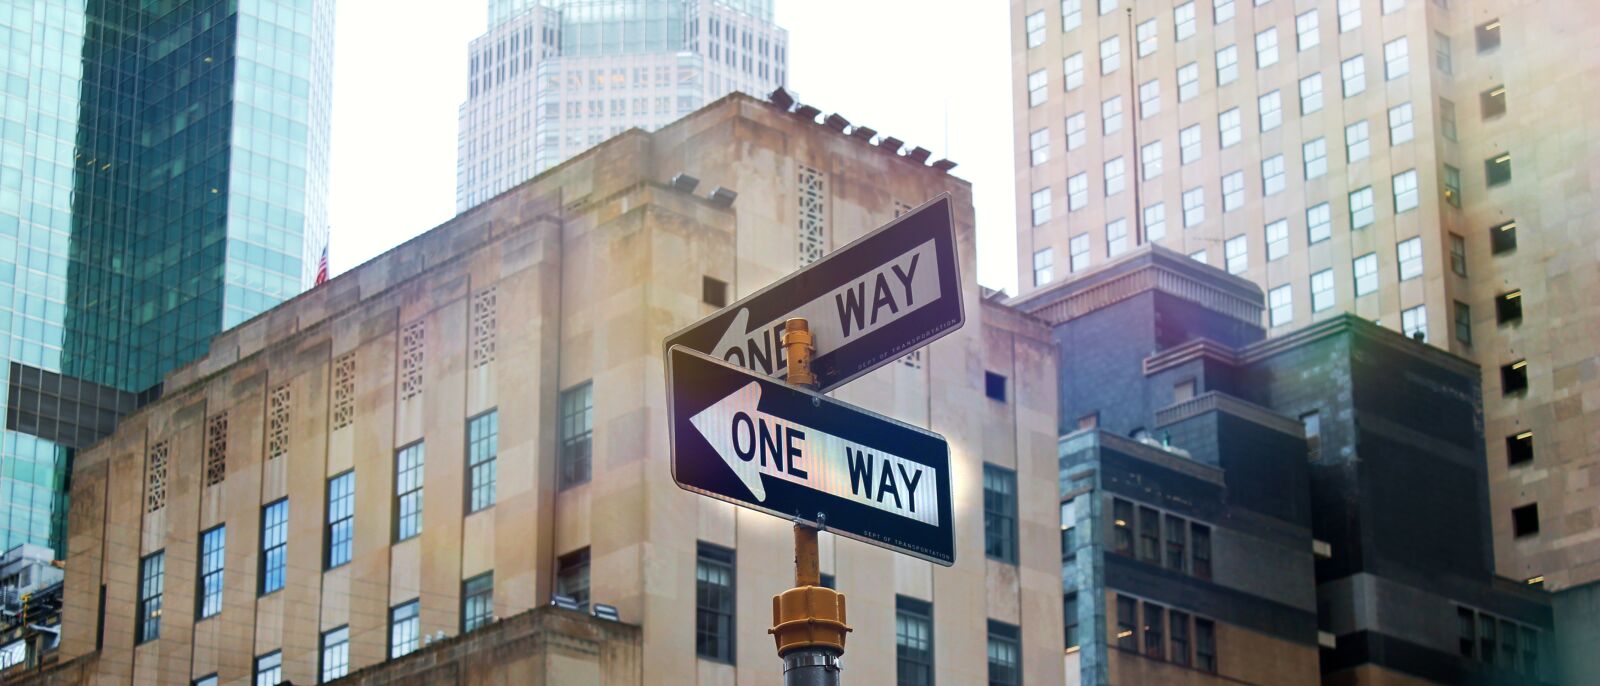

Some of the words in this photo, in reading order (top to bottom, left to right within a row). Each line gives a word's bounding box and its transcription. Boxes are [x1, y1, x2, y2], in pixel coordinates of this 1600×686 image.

[835, 253, 920, 338] WAY
[880, 351, 889, 359] OF
[892, 318, 957, 353] TRANSPORTATION
[732, 411, 808, 480] ONE
[846, 446, 922, 513] WAY
[895, 539, 950, 560] TRANSPORTATION
